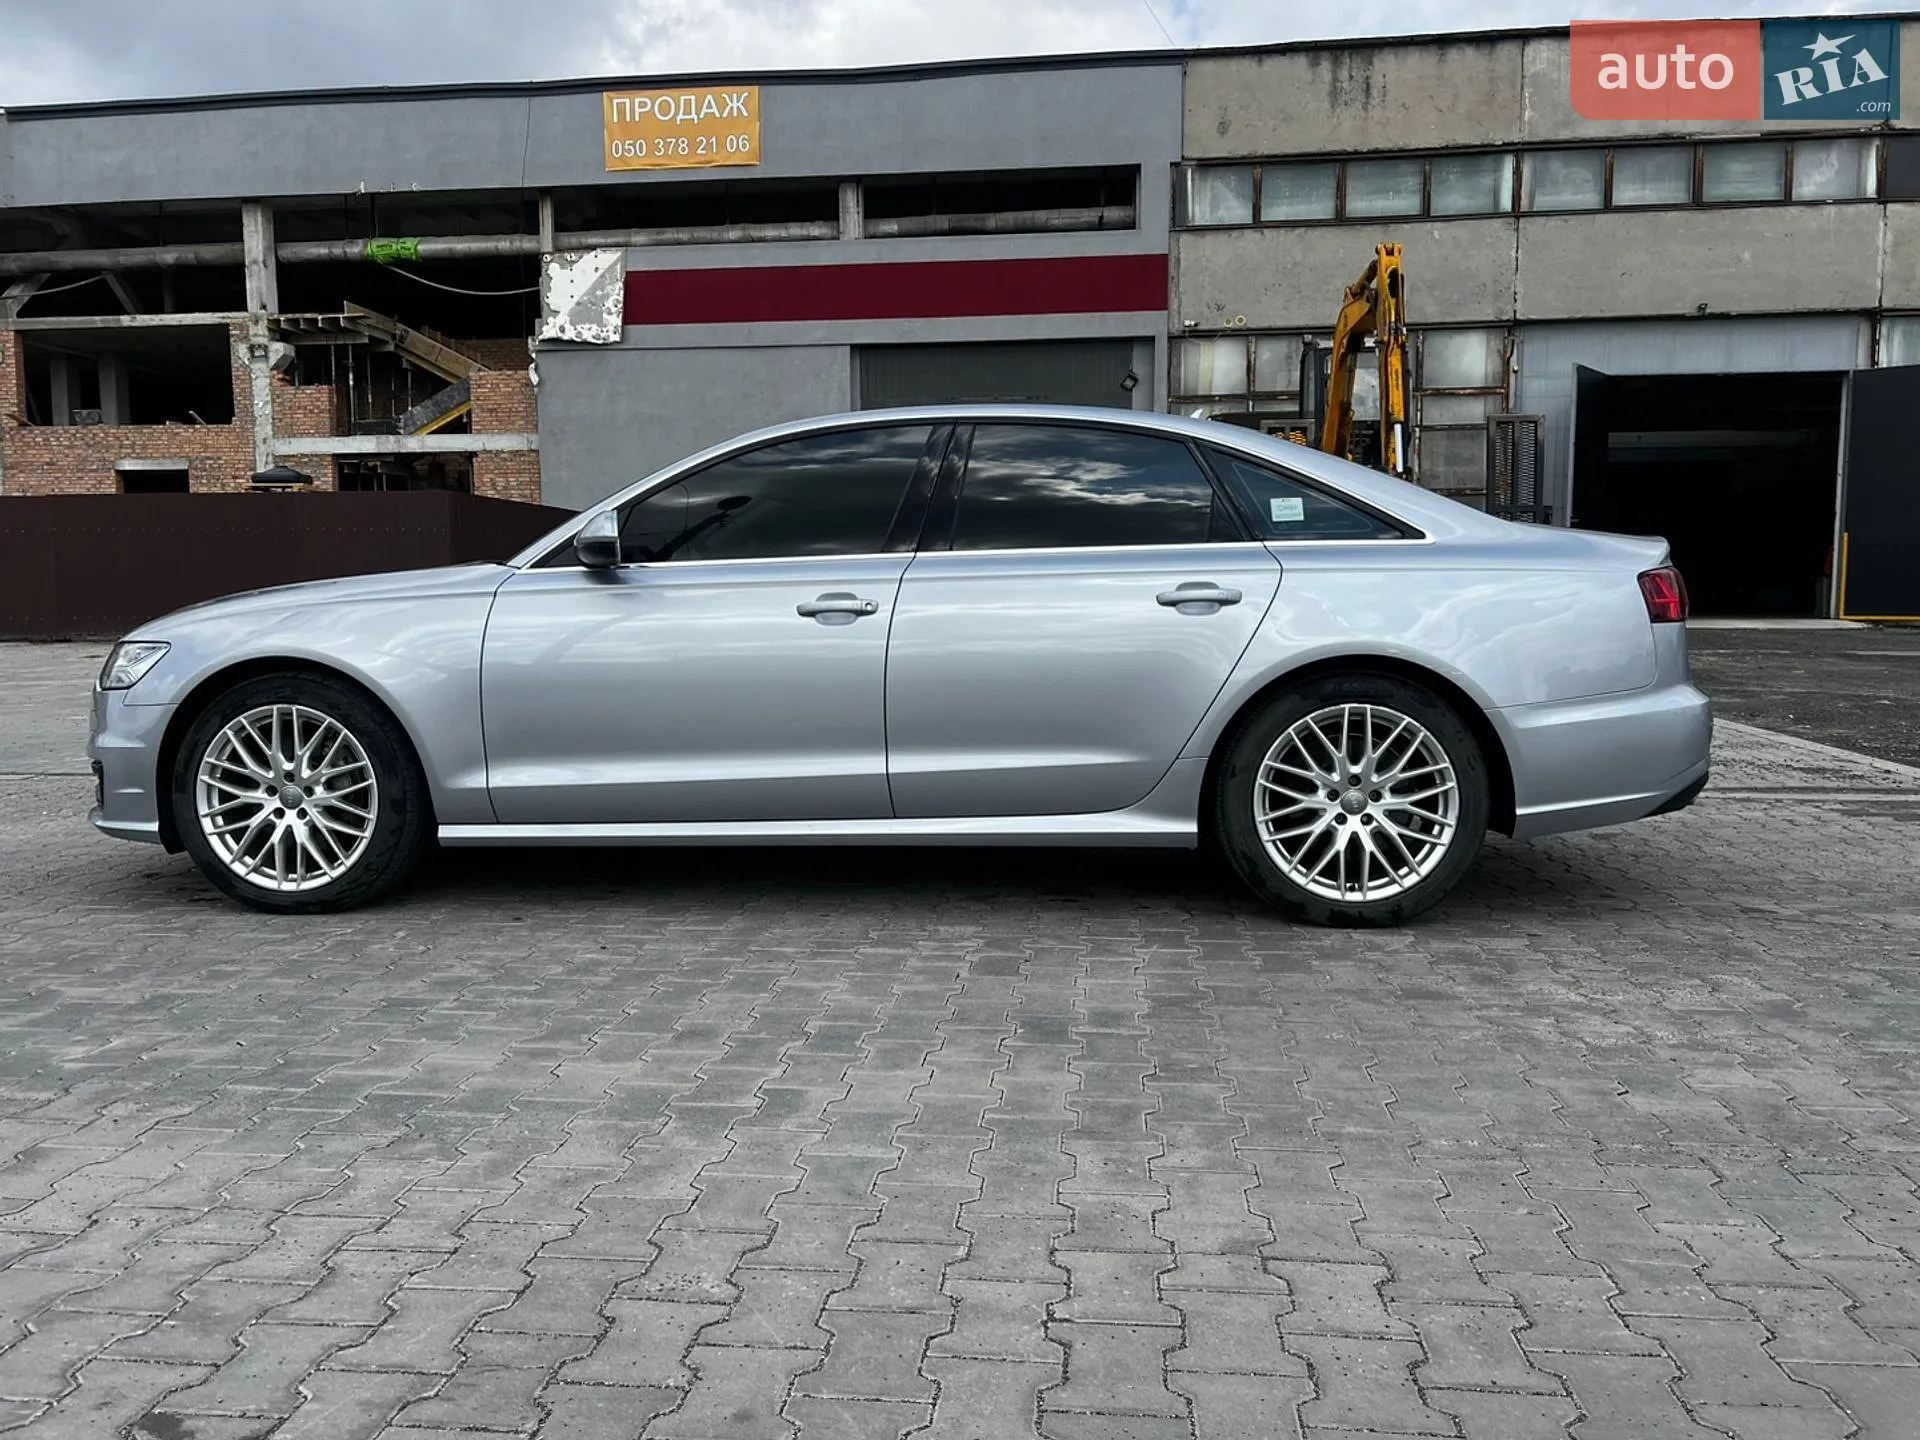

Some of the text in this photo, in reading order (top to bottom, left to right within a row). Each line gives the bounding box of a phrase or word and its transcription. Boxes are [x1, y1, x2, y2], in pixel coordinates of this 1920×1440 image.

[612, 92, 749, 124] ПРОДАЖ
[611, 134, 750, 158] 050 378 21 06
